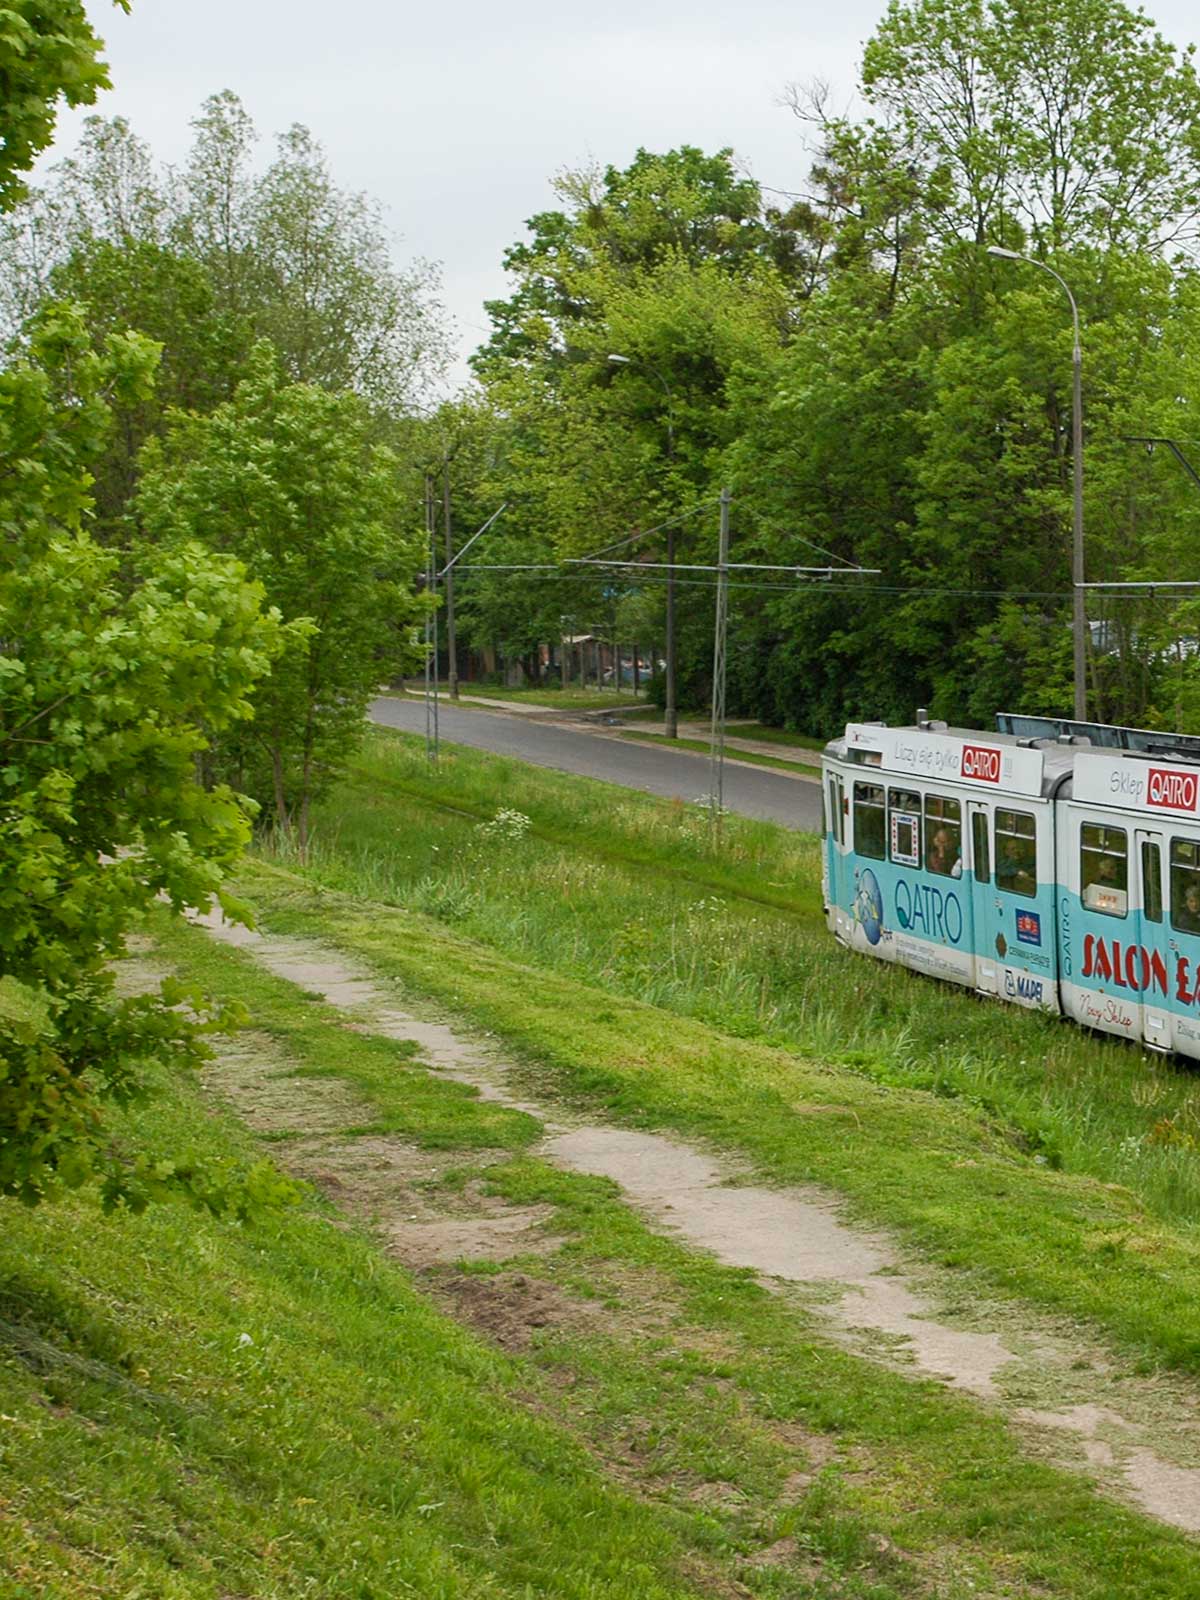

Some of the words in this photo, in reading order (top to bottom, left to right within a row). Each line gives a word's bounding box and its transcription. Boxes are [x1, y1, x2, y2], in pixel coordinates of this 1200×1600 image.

[895, 741, 918, 767] Liczy
[963, 749, 999, 779] QATRO
[1111, 771, 1144, 803] Sklep
[1150, 773, 1195, 807] QATRO
[895, 879, 962, 943] QATRO
[1061, 898, 1072, 976] QATRO
[1082, 933, 1168, 998] SALON
[1104, 1000, 1132, 1033] Sklep
